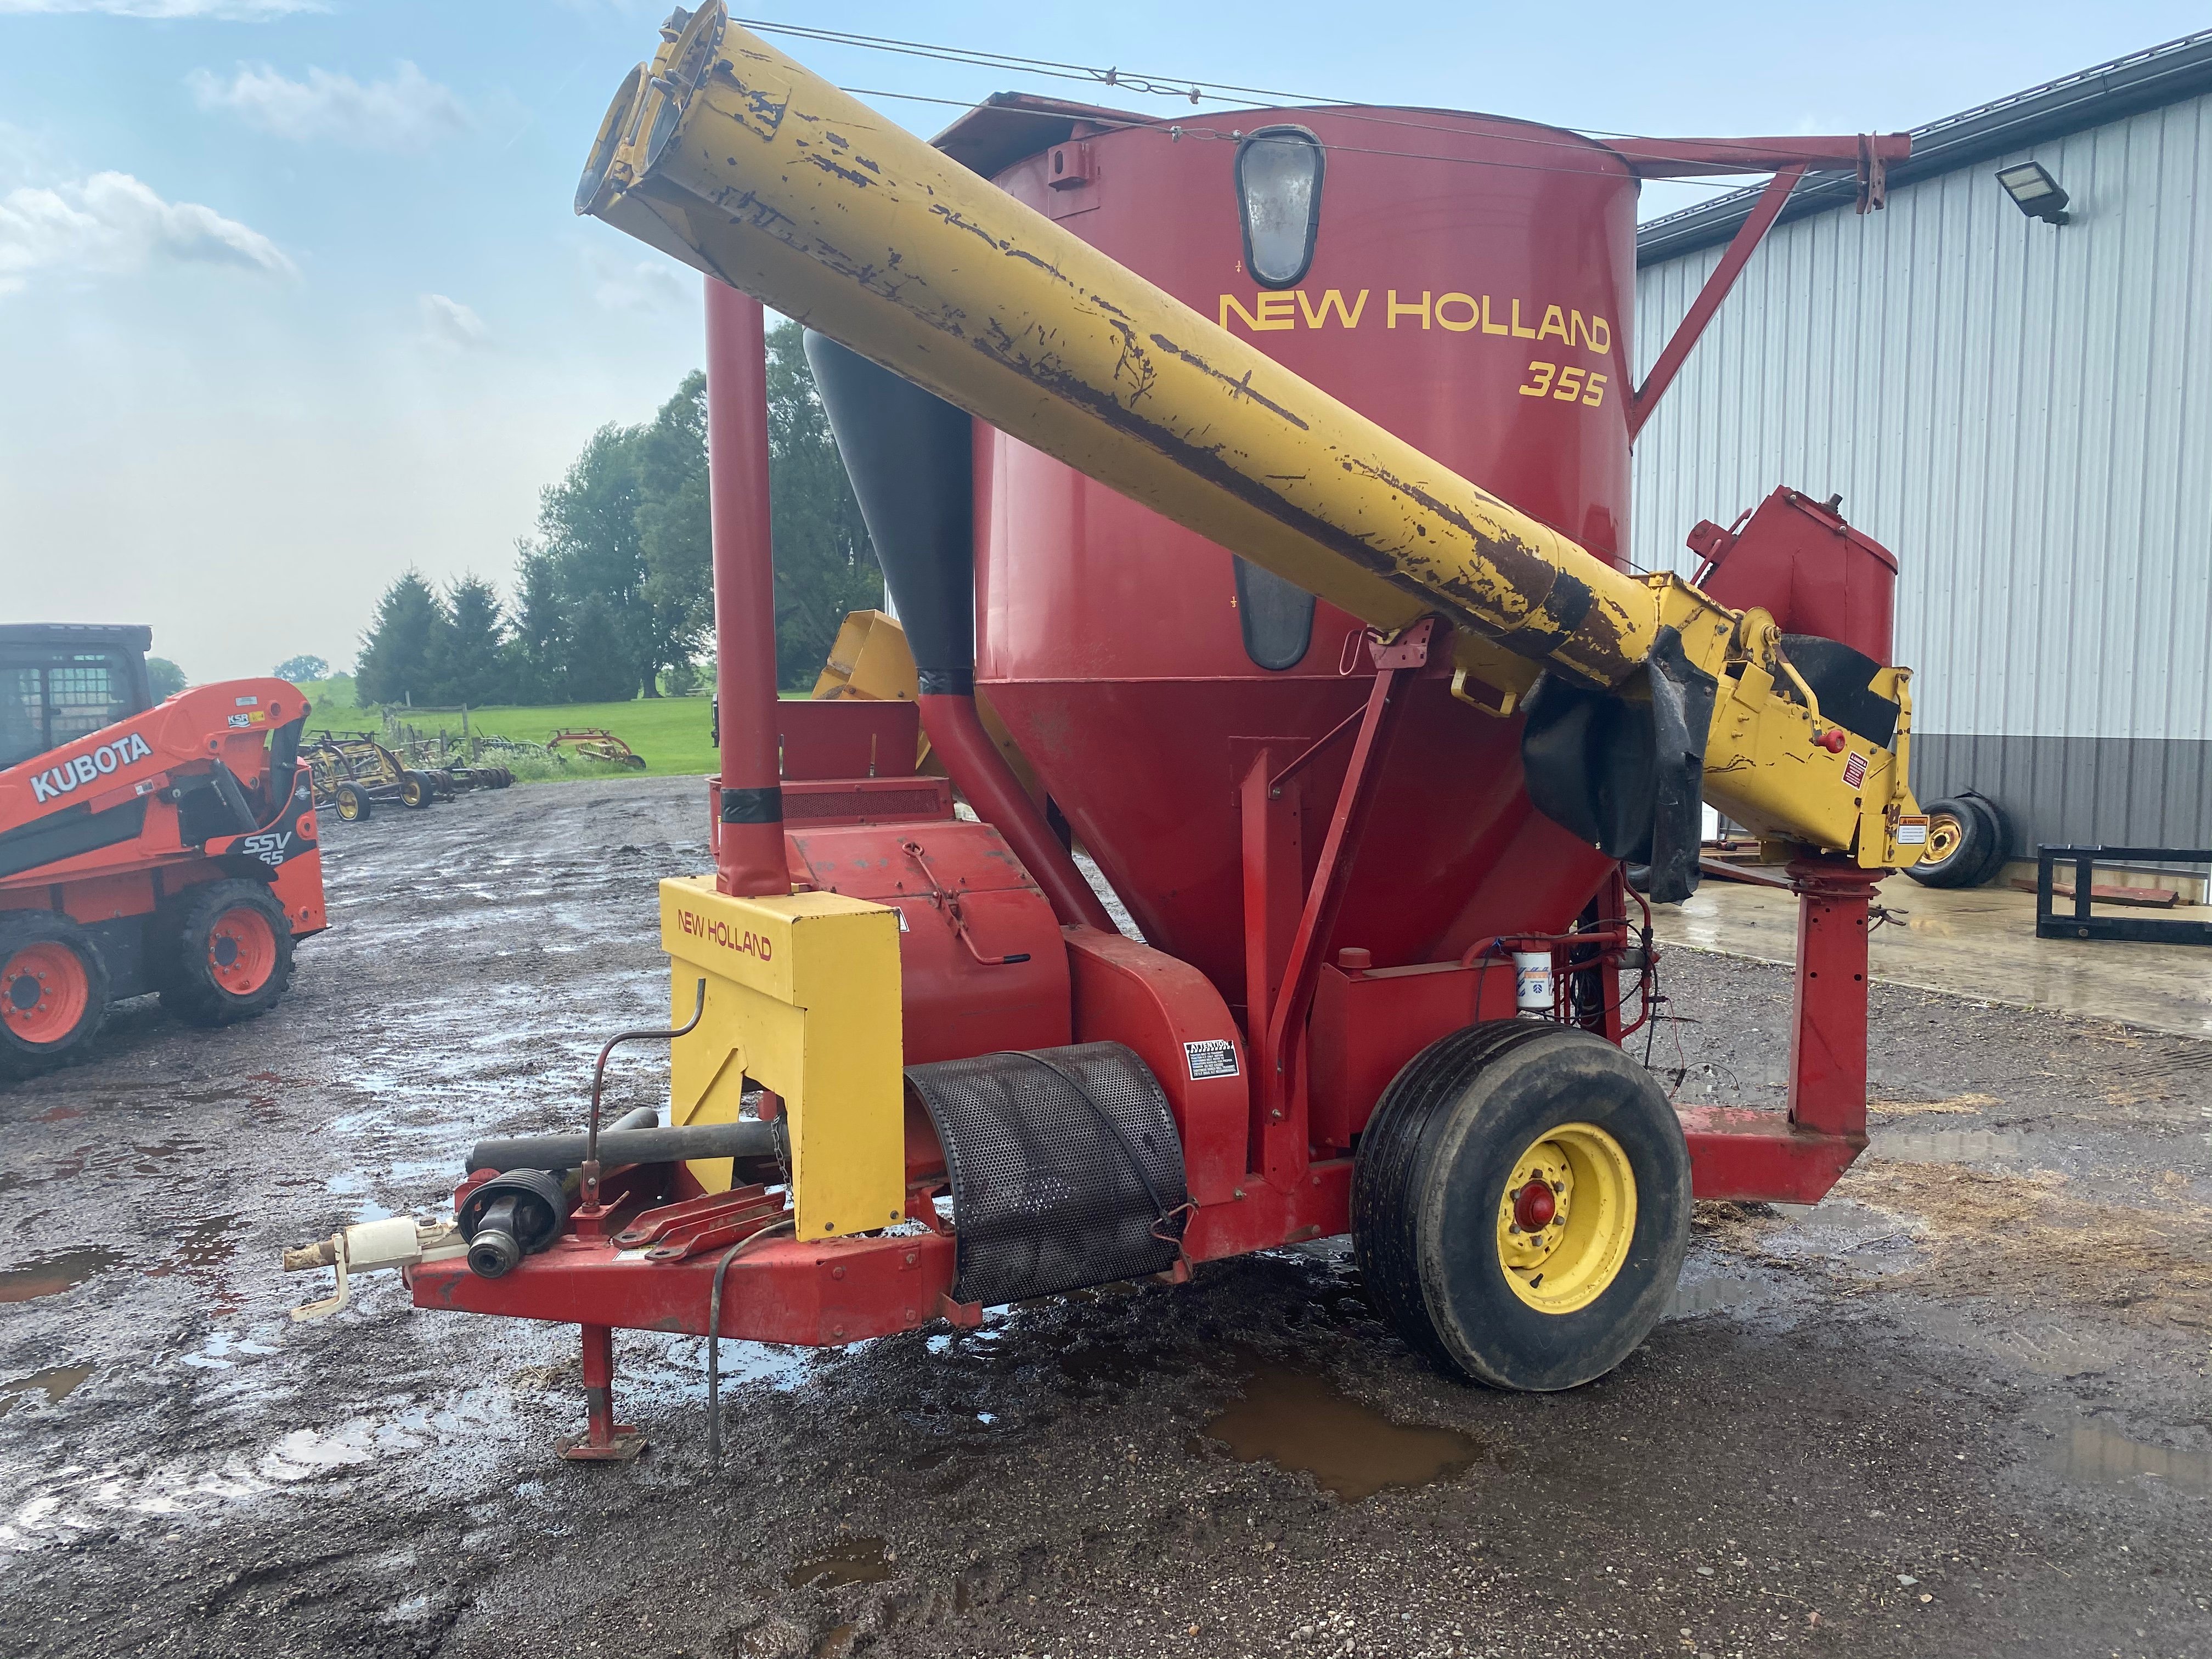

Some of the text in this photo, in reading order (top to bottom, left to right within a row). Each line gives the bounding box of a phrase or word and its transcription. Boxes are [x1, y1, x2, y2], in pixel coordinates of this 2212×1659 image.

[1220, 289, 1611, 355] NEW HOLLAND
[1519, 361, 1608, 407] 355
[30, 732, 153, 803] KUBOTA
[242, 831, 292, 854] SSV
[678, 909, 772, 962] NEW HOLLAND
[1191, 1041, 1229, 1049] ATTENTION
